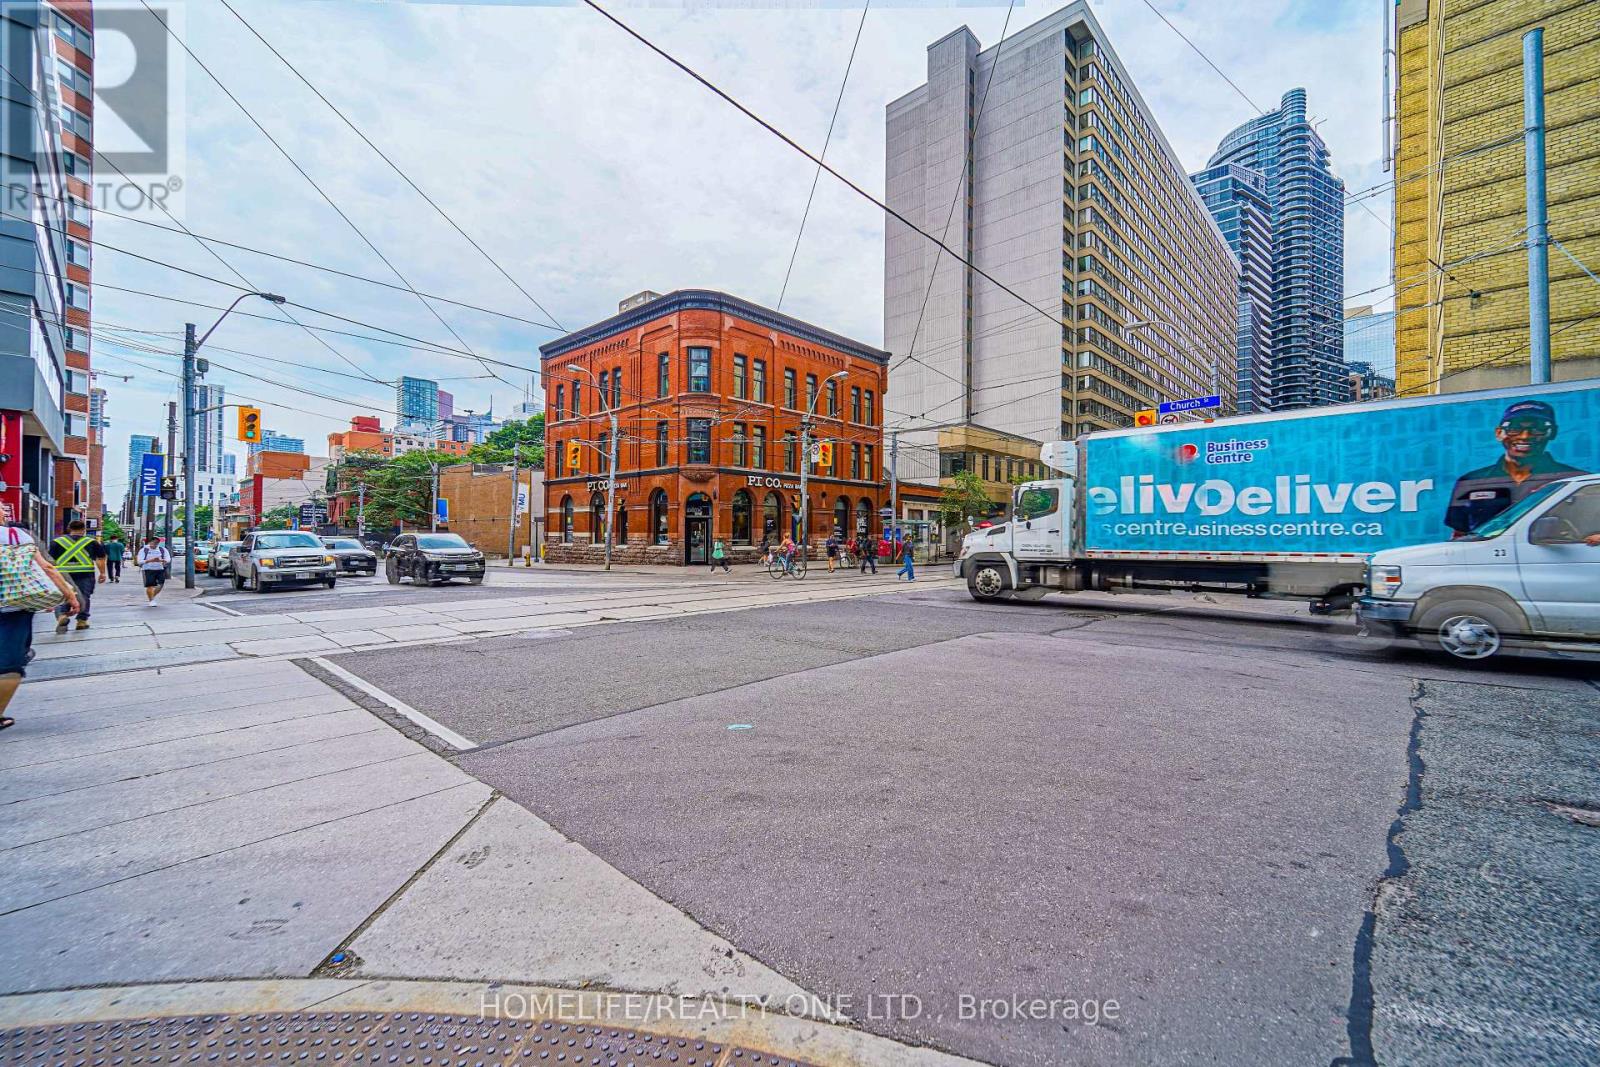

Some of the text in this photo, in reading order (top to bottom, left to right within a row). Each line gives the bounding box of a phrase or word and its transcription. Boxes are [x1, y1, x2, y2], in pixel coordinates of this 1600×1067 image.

[1170, 399, 1201, 411] Church
[1206, 439, 1268, 453] Business
[1206, 452, 1252, 464] Centre
[143, 468, 157, 493] TMU
[765, 477, 782, 488] CO.
